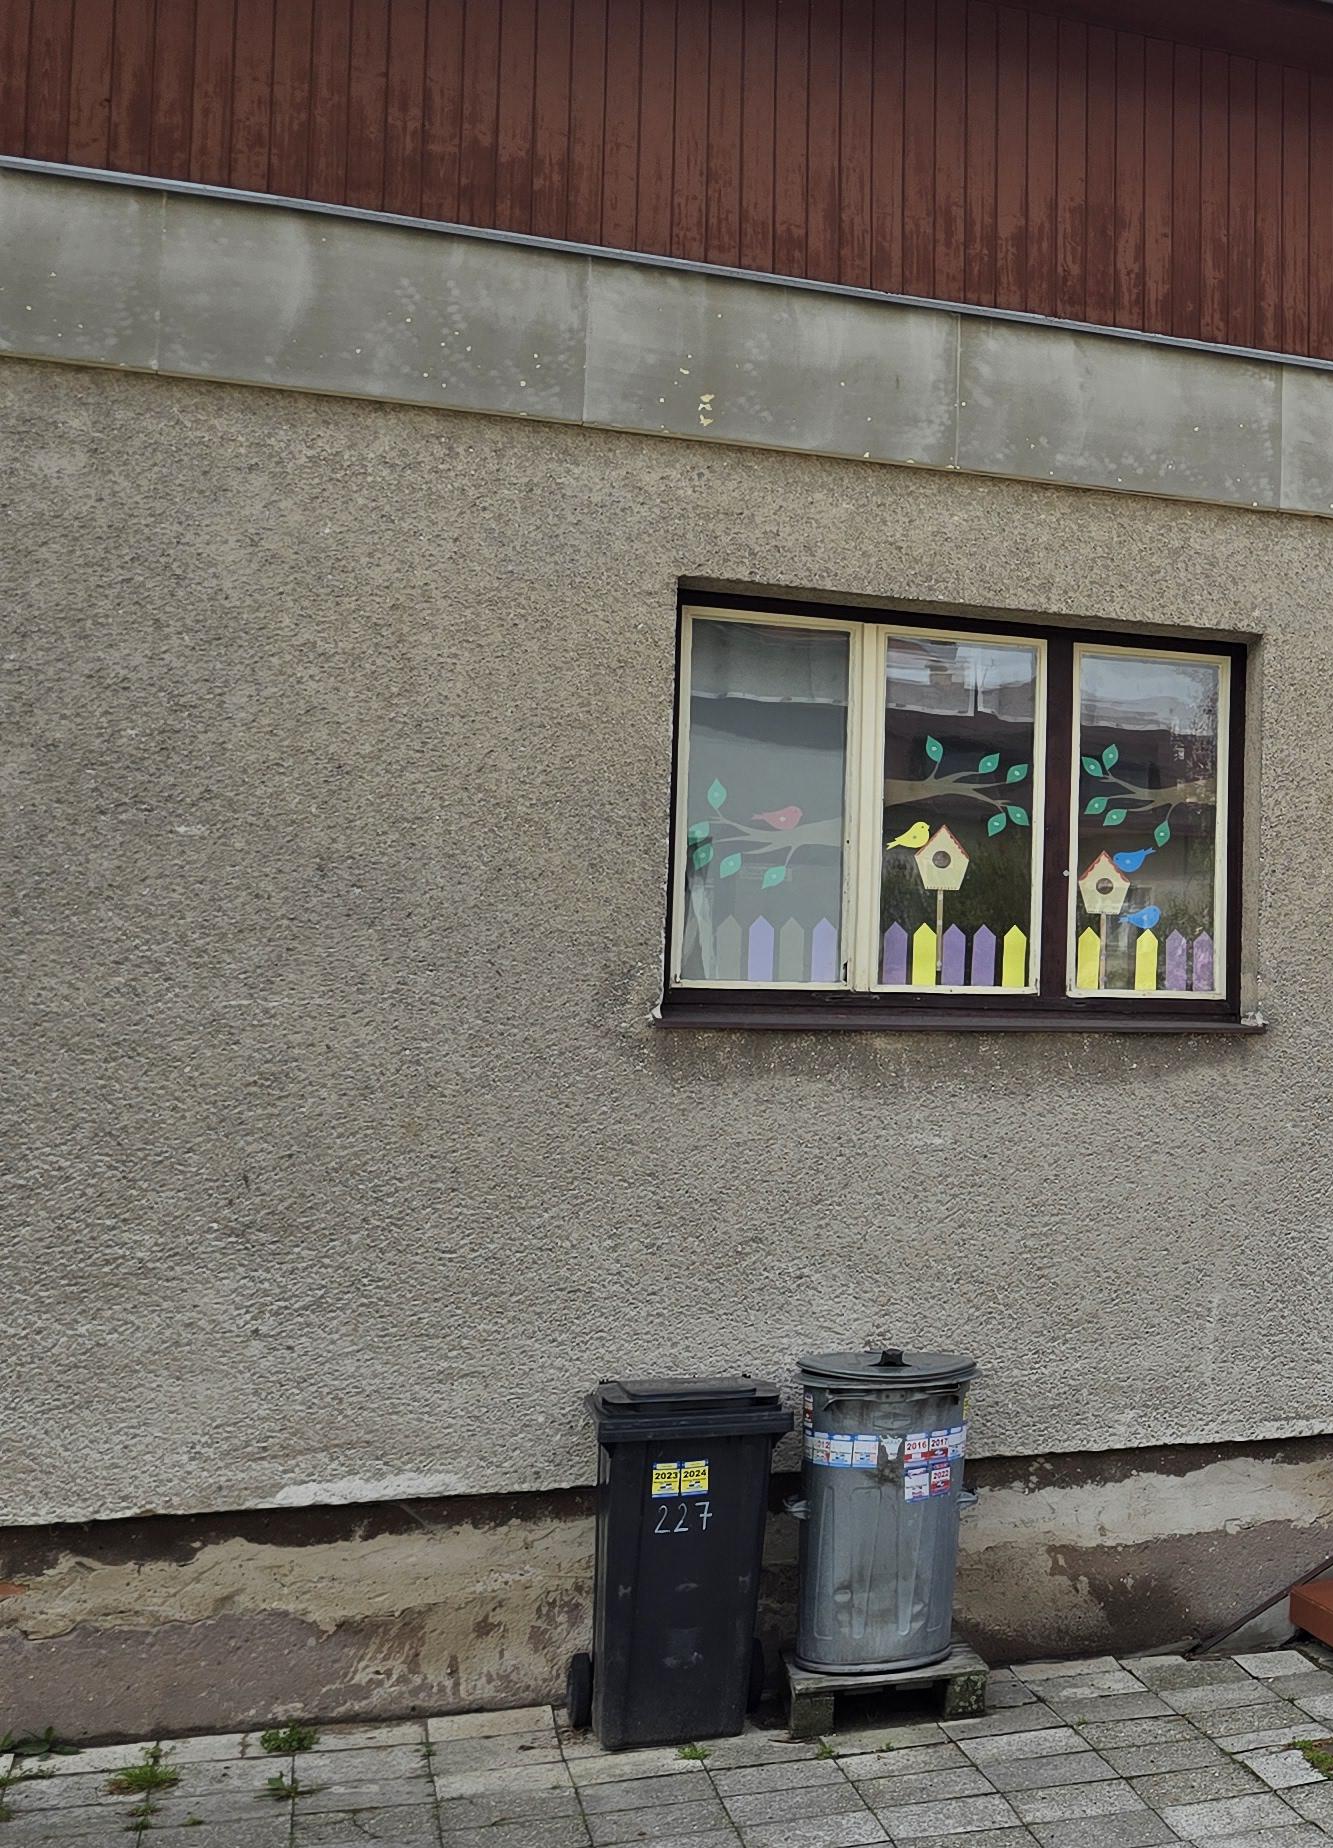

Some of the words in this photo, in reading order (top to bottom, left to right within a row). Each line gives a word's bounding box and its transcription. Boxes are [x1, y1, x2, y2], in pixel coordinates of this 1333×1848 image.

[906, 1440, 928, 1451] 2016
[930, 1438, 949, 1448] 2017
[654, 1471, 679, 1480] 2023
[683, 1469, 707, 1479] 2024
[933, 1470, 949, 1480] 2022
[654, 1501, 713, 1534] 227
